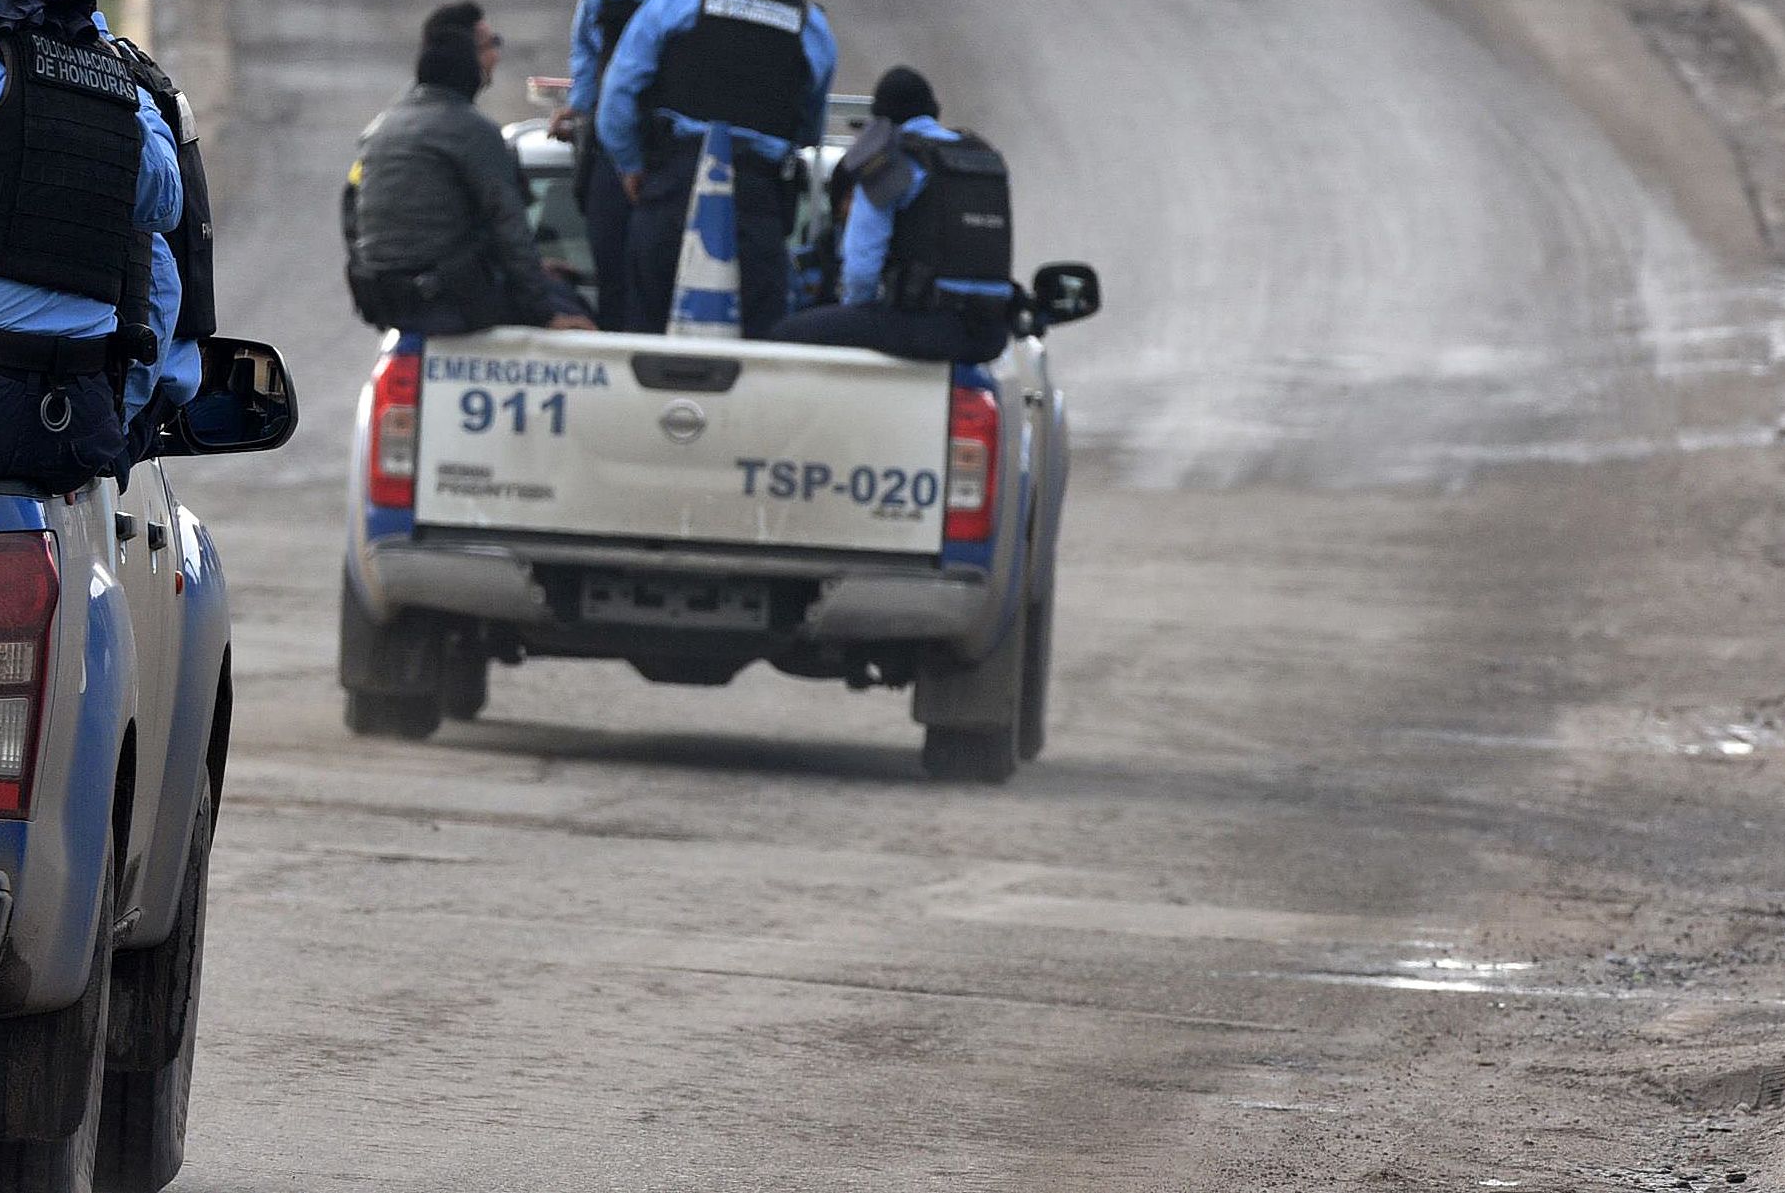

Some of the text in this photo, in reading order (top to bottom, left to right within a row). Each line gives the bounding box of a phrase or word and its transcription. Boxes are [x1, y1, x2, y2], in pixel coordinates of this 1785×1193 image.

[32, 34, 133, 81] POLICIA NACIONAL
[36, 55, 136, 101] DE HONDURAS
[427, 356, 610, 386] EMERGENCIA
[459, 388, 566, 435] 911
[735, 458, 939, 507] TSP-020
